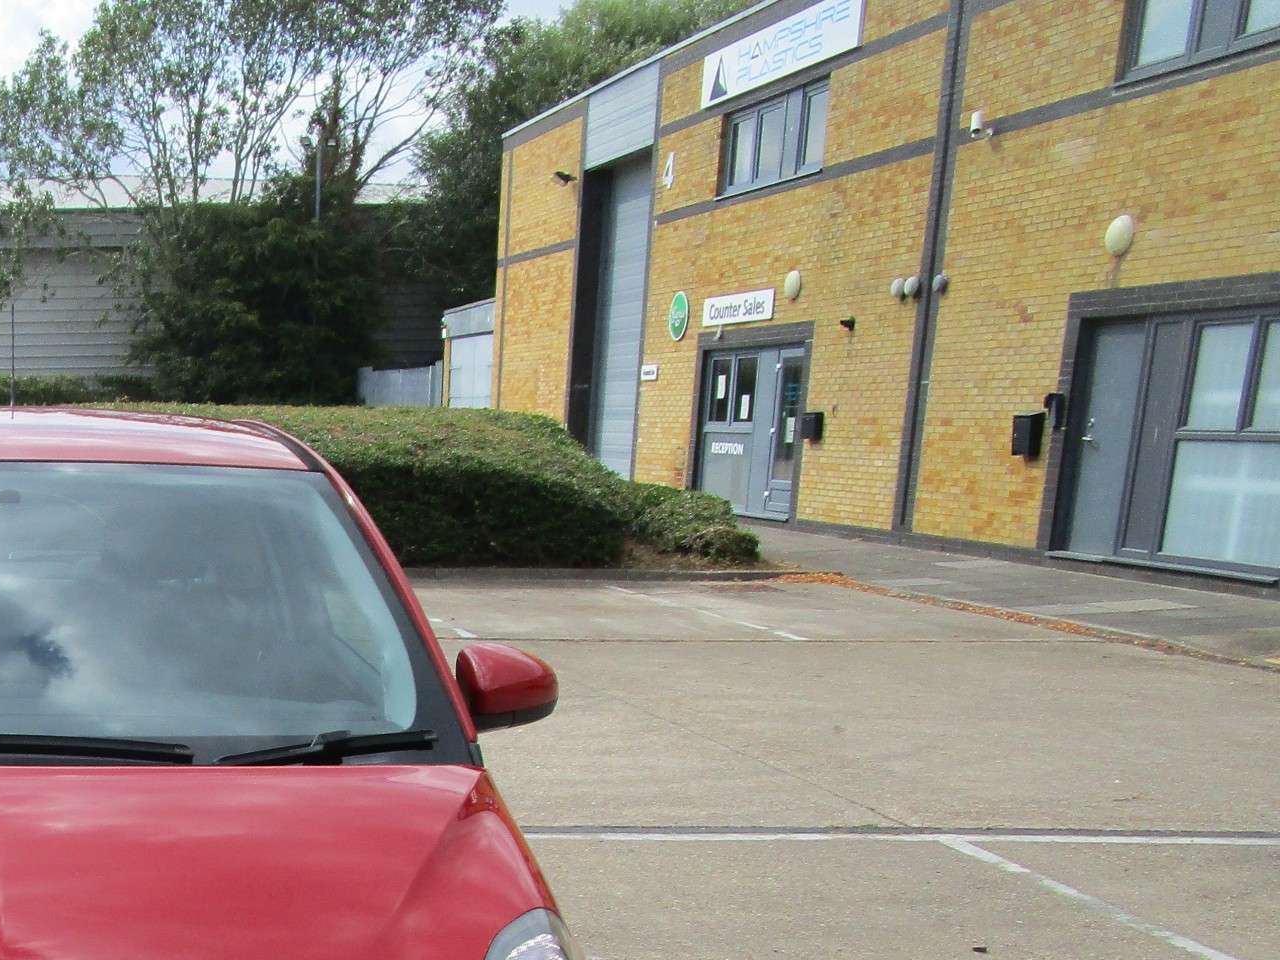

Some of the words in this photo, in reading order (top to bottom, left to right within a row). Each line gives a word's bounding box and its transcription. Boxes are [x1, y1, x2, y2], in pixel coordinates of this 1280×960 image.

[738, 0, 851, 61] HAMPSHIRE
[737, 33, 824, 81] PLASTICS
[662, 151, 675, 190] 4
[709, 301, 741, 321] Counter
[743, 297, 766, 316] Sales
[711, 442, 744, 455] RECEPTION
